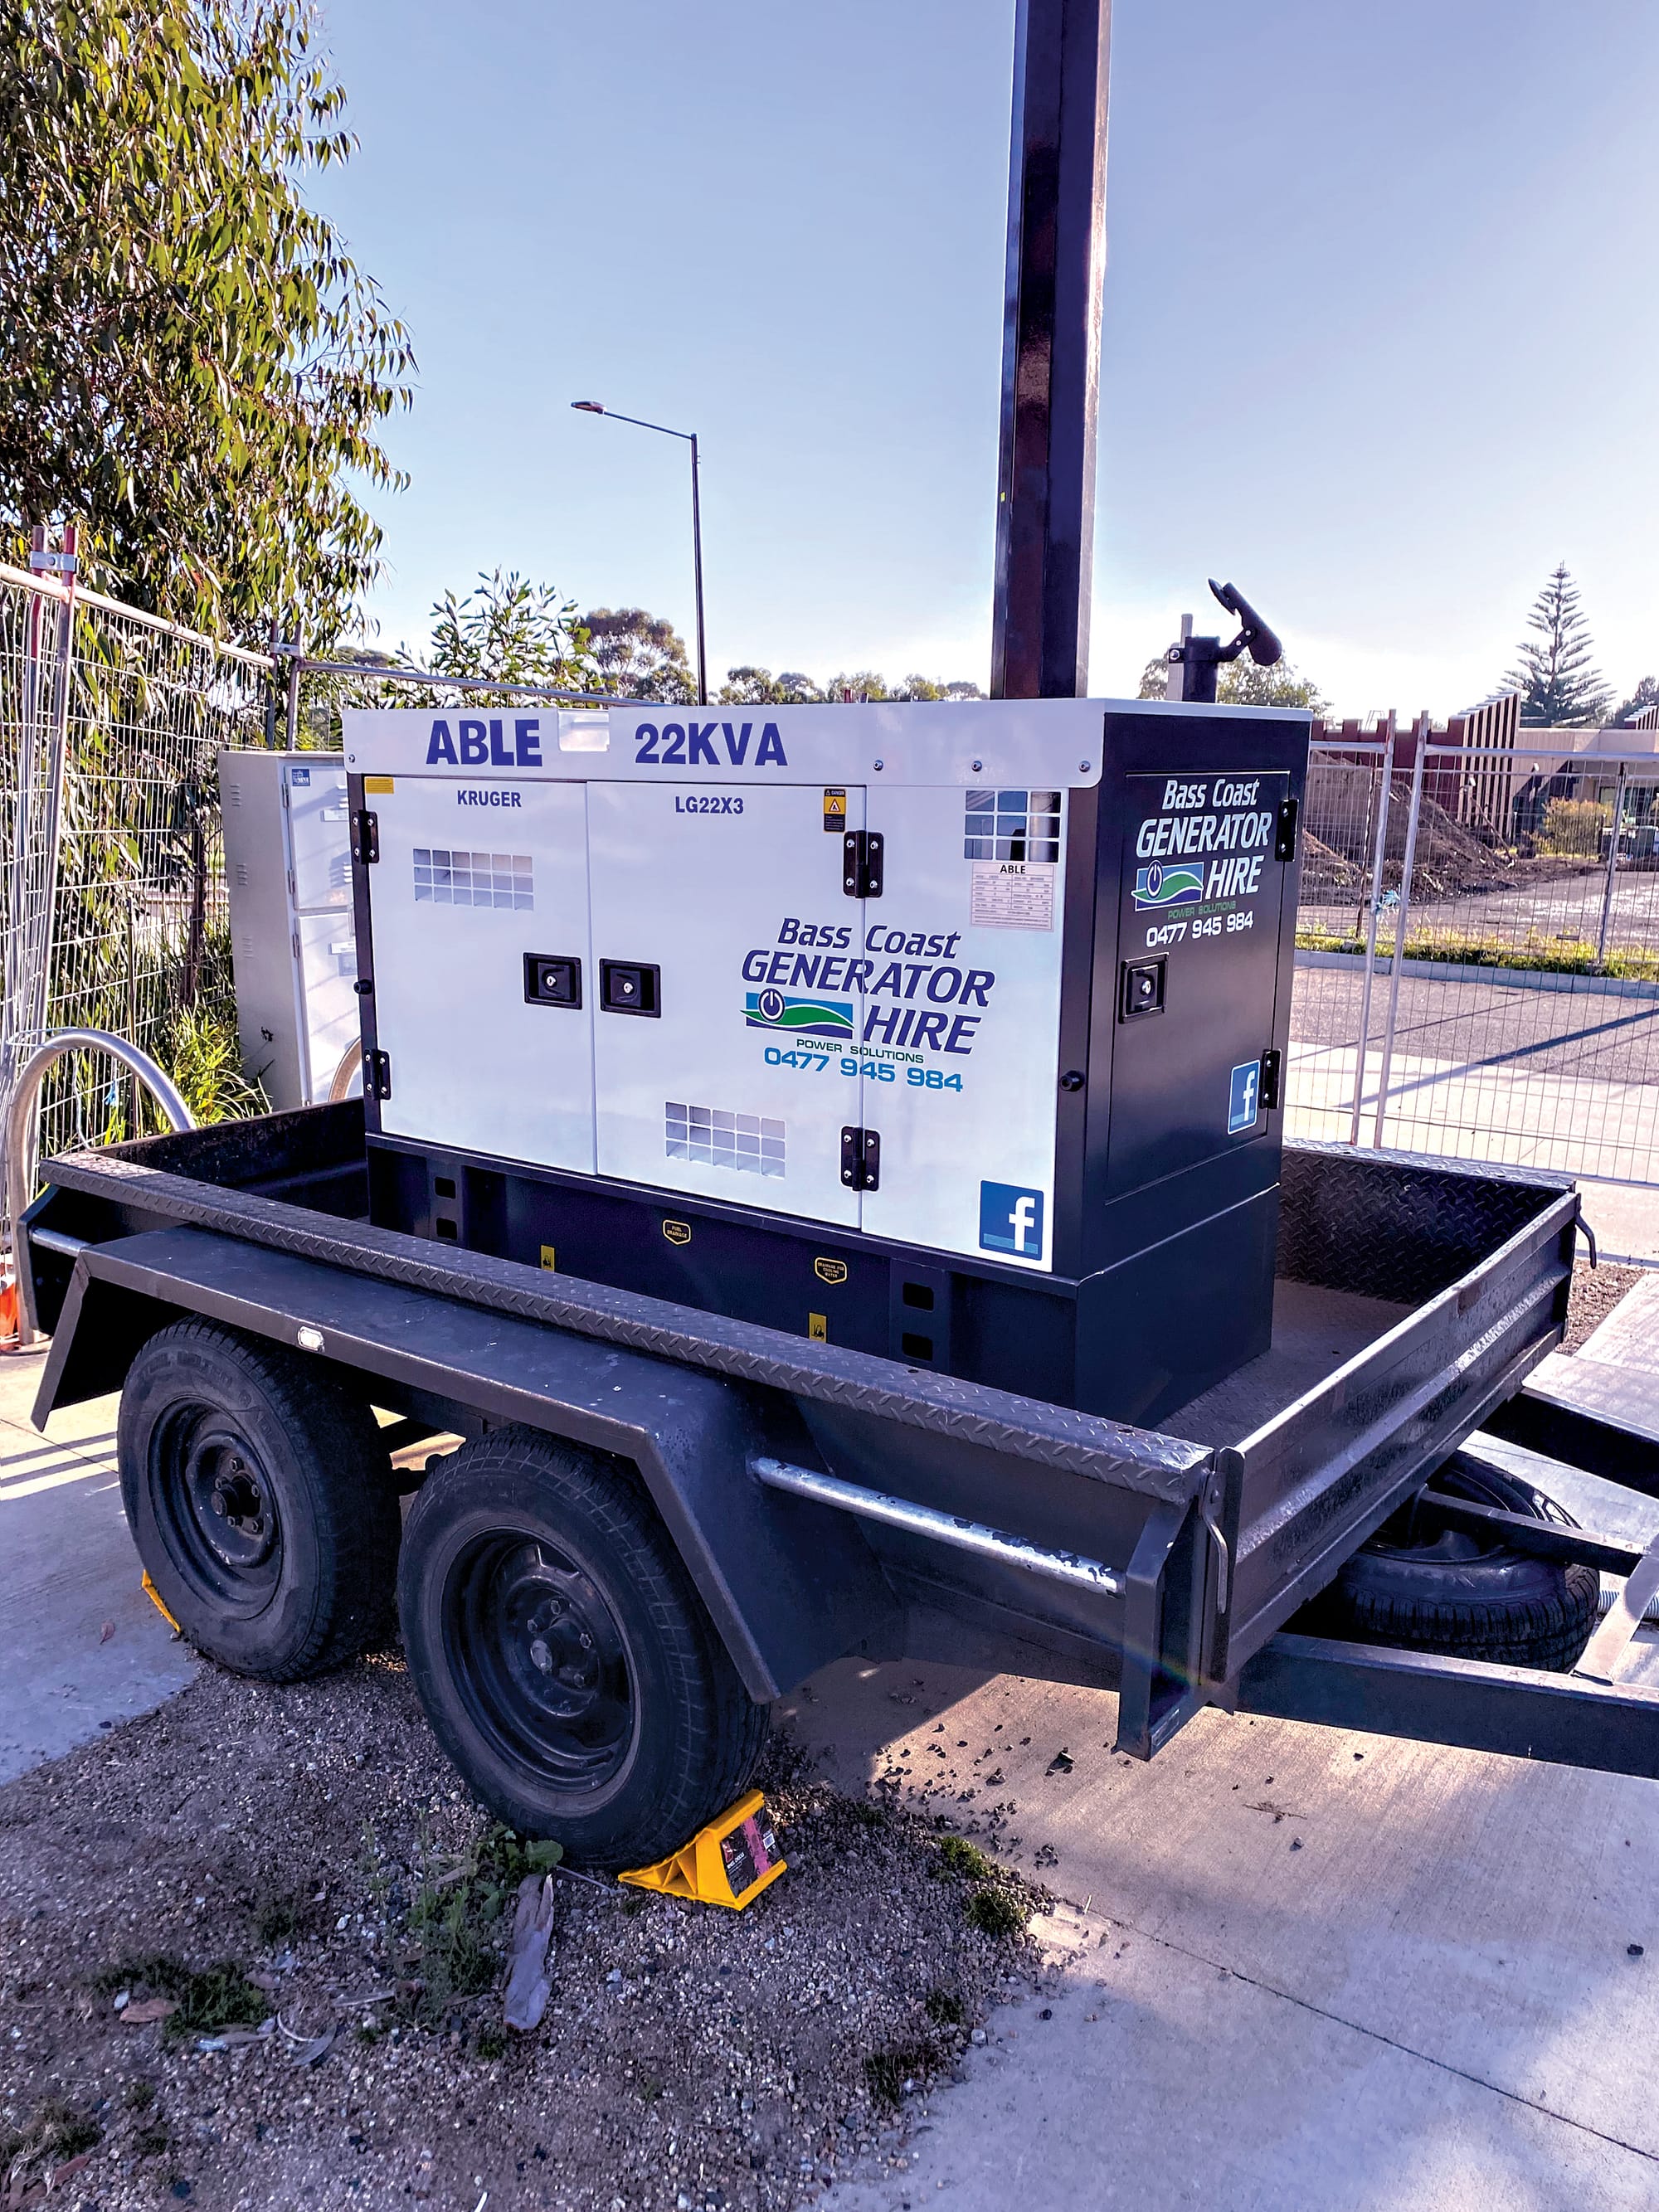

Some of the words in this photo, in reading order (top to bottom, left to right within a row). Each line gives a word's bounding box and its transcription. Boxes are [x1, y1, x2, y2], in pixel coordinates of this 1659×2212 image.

[426, 719, 542, 767] ABLE
[635, 722, 788, 766] 22KVA
[457, 790, 522, 808] KRUGER
[675, 795, 744, 814] LG22X3
[1161, 780, 1208, 810] Bass
[1212, 778, 1260, 807] Coast
[1136, 811, 1272, 858] GENERATOR
[1000, 864, 1026, 874] ABLE
[1204, 855, 1265, 900] HIRE
[1146, 921, 1188, 947] 0477
[1191, 916, 1223, 939] 945
[1226, 910, 1253, 933] 984
[1168, 907, 1195, 921] POWER
[1198, 900, 1236, 915] SOLUTIONS
[777, 917, 852, 949] Bass
[865, 925, 962, 959] Coast
[742, 949, 995, 1008] GENERATOR
[796, 1038, 843, 1053] POWER
[850, 1045, 924, 1063] SOLUTIONS
[864, 1004, 981, 1055] HIRE
[764, 1047, 830, 1072] 0477
[840, 1057, 895, 1082] 945
[907, 1067, 963, 1092] 984
